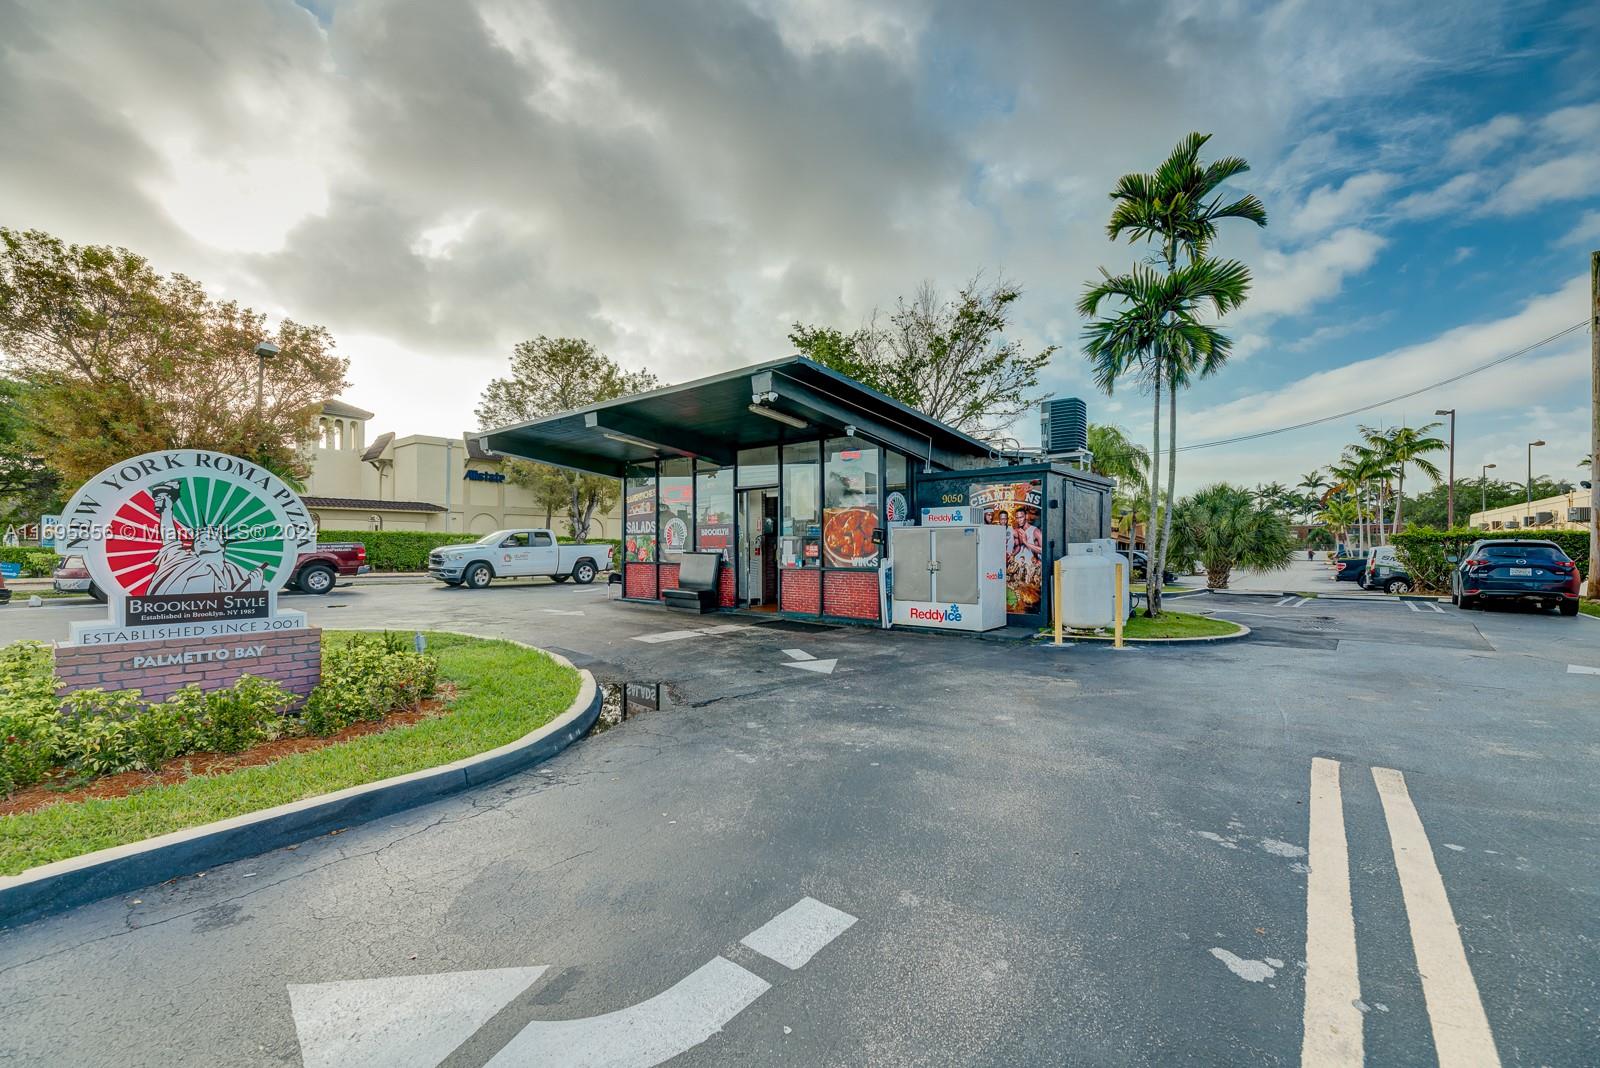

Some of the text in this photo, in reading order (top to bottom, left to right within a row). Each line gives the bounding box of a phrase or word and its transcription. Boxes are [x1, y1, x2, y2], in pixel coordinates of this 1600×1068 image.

[463, 469, 506, 483] Allstate
[66, 453, 312, 550] NEW YORK ROMA PIZZA
[942, 494, 963, 504] 9050
[970, 490, 1041, 506] CHAMPINS
[626, 520, 656, 534] SALADS
[701, 528, 729, 536] BROOKLYN
[851, 556, 879, 567] WINGS
[141, 613, 182, 621] Established
[83, 619, 299, 644] ESTABLISHED SINCE 2001
[133, 645, 266, 668] PALMETTO BAY
